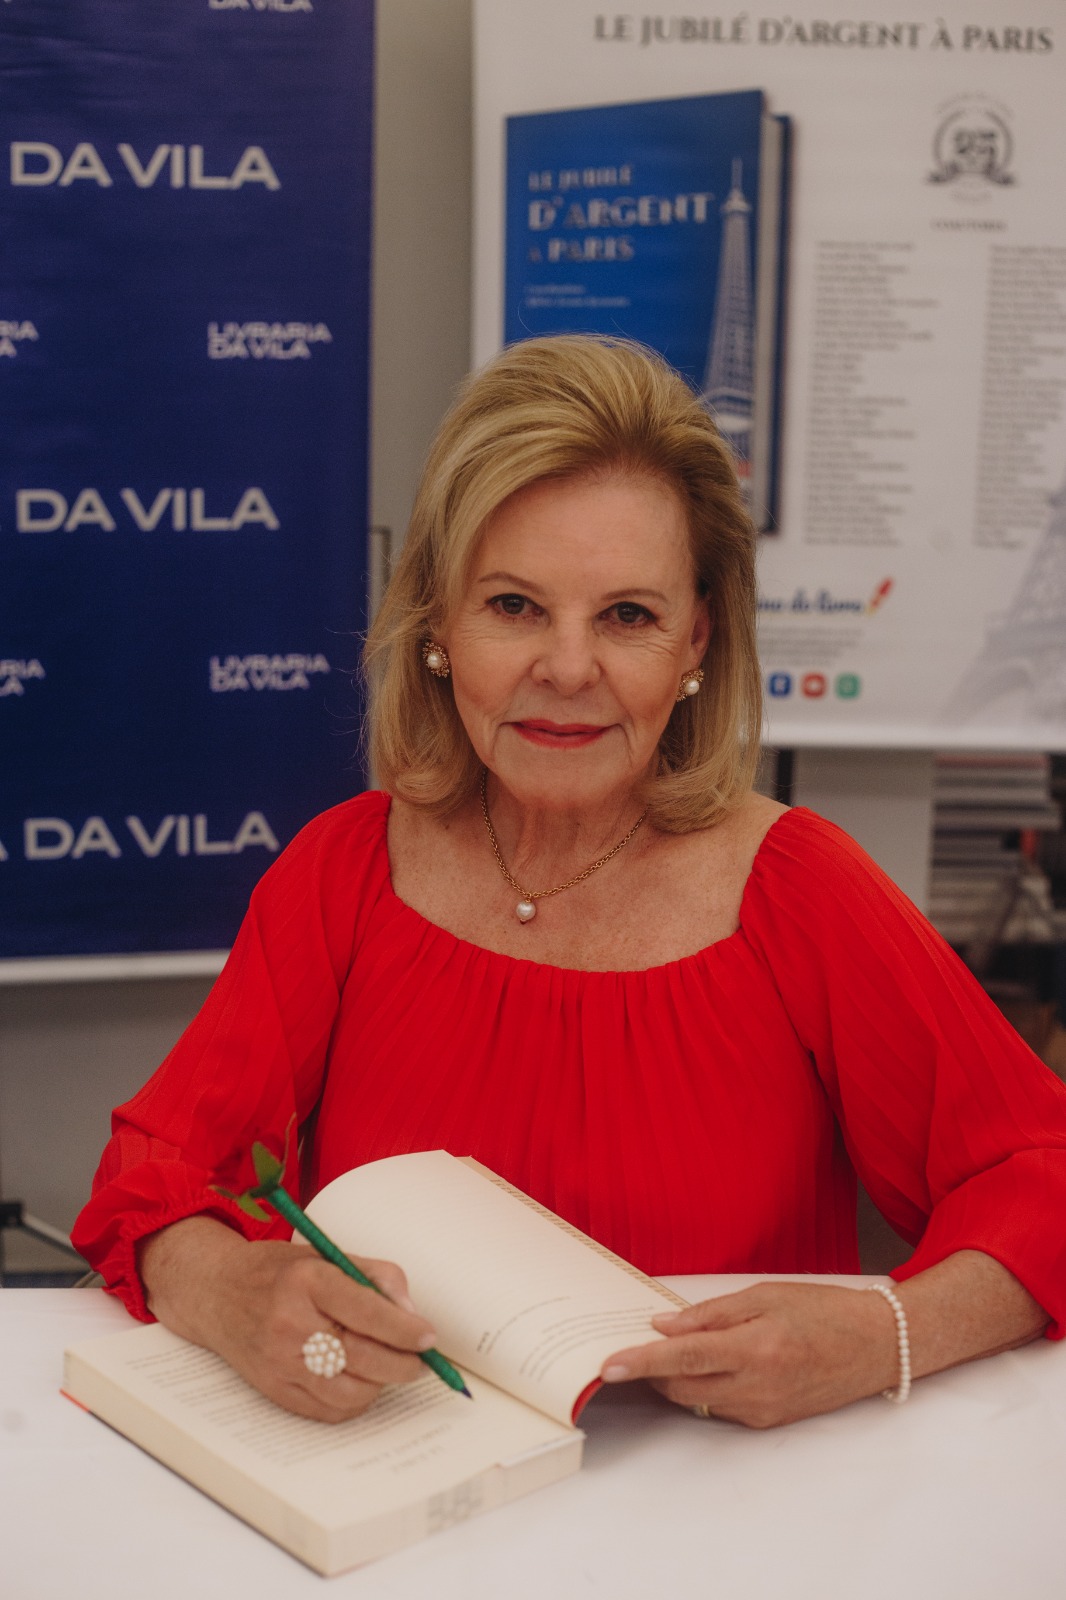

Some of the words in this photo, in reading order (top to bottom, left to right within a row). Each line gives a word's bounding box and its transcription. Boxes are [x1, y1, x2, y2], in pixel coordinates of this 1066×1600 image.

[593, 13, 632, 42] LE
[638, 10, 751, 48] JUBILÉ
[757, 14, 926, 50] D'ARGENT
[930, 16, 955, 50] À
[961, 23, 1055, 55] PARIS
[10, 141, 113, 188] DA
[117, 143, 282, 191] VILA
[528, 192, 713, 231] D'ARGENT
[547, 235, 635, 263] PARIS
[207, 321, 333, 343] LIVRARIA
[207, 340, 249, 359] DA
[247, 340, 312, 359] VILA
[15, 488, 117, 533] DA
[120, 486, 280, 532] VILA
[209, 653, 331, 675] LIVRARIA
[209, 671, 249, 692] DA
[248, 669, 311, 691] VILA
[23, 817, 122, 861] DA
[125, 811, 280, 857] VILA
